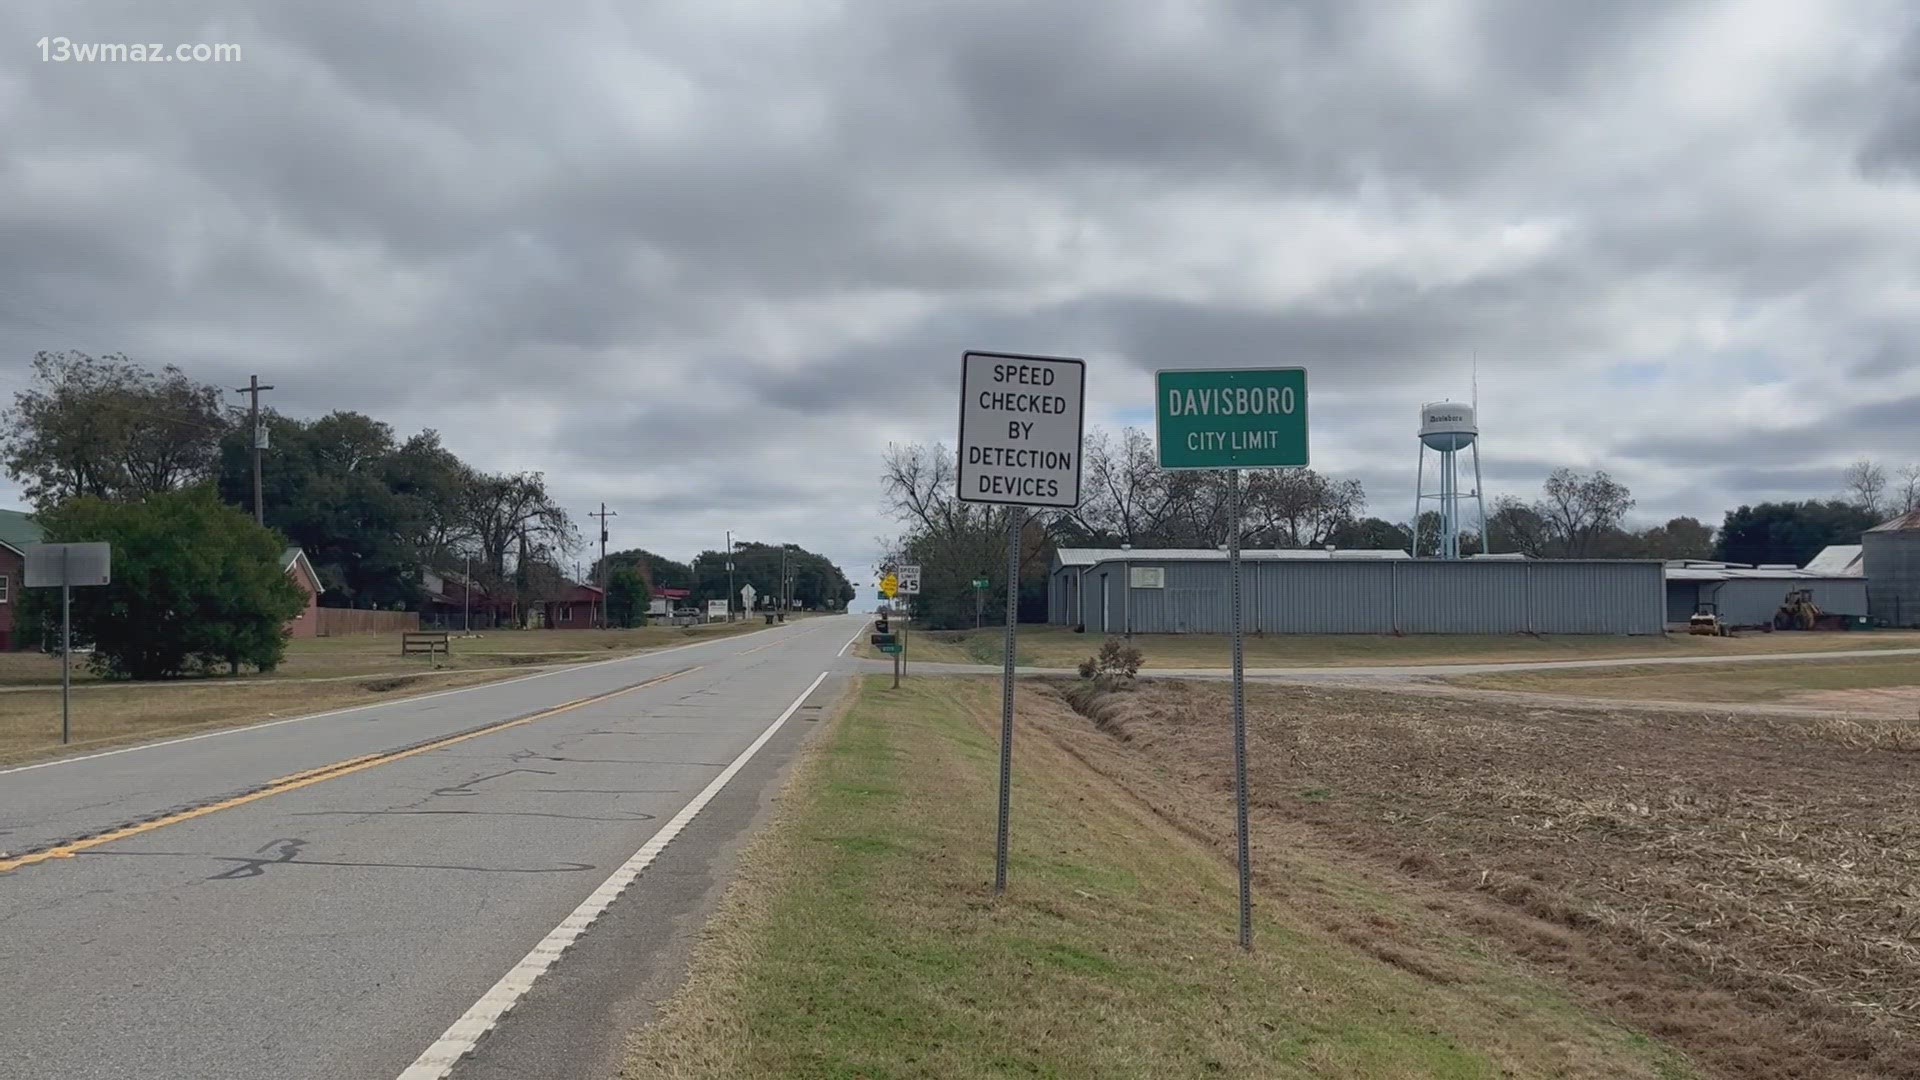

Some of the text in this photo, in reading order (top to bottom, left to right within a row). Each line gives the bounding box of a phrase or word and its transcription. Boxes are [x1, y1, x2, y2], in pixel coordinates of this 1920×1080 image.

[993, 365, 1055, 387] SPEED
[979, 391, 1066, 415] CHECKED
[1169, 387, 1295, 416] DAVISBORO
[1008, 421, 1034, 440] BY
[1187, 430, 1279, 451] CITY LIMIT
[969, 446, 1071, 471] DETECTION
[979, 475, 1058, 498] DEVICES
[899, 580, 918, 591] 45
